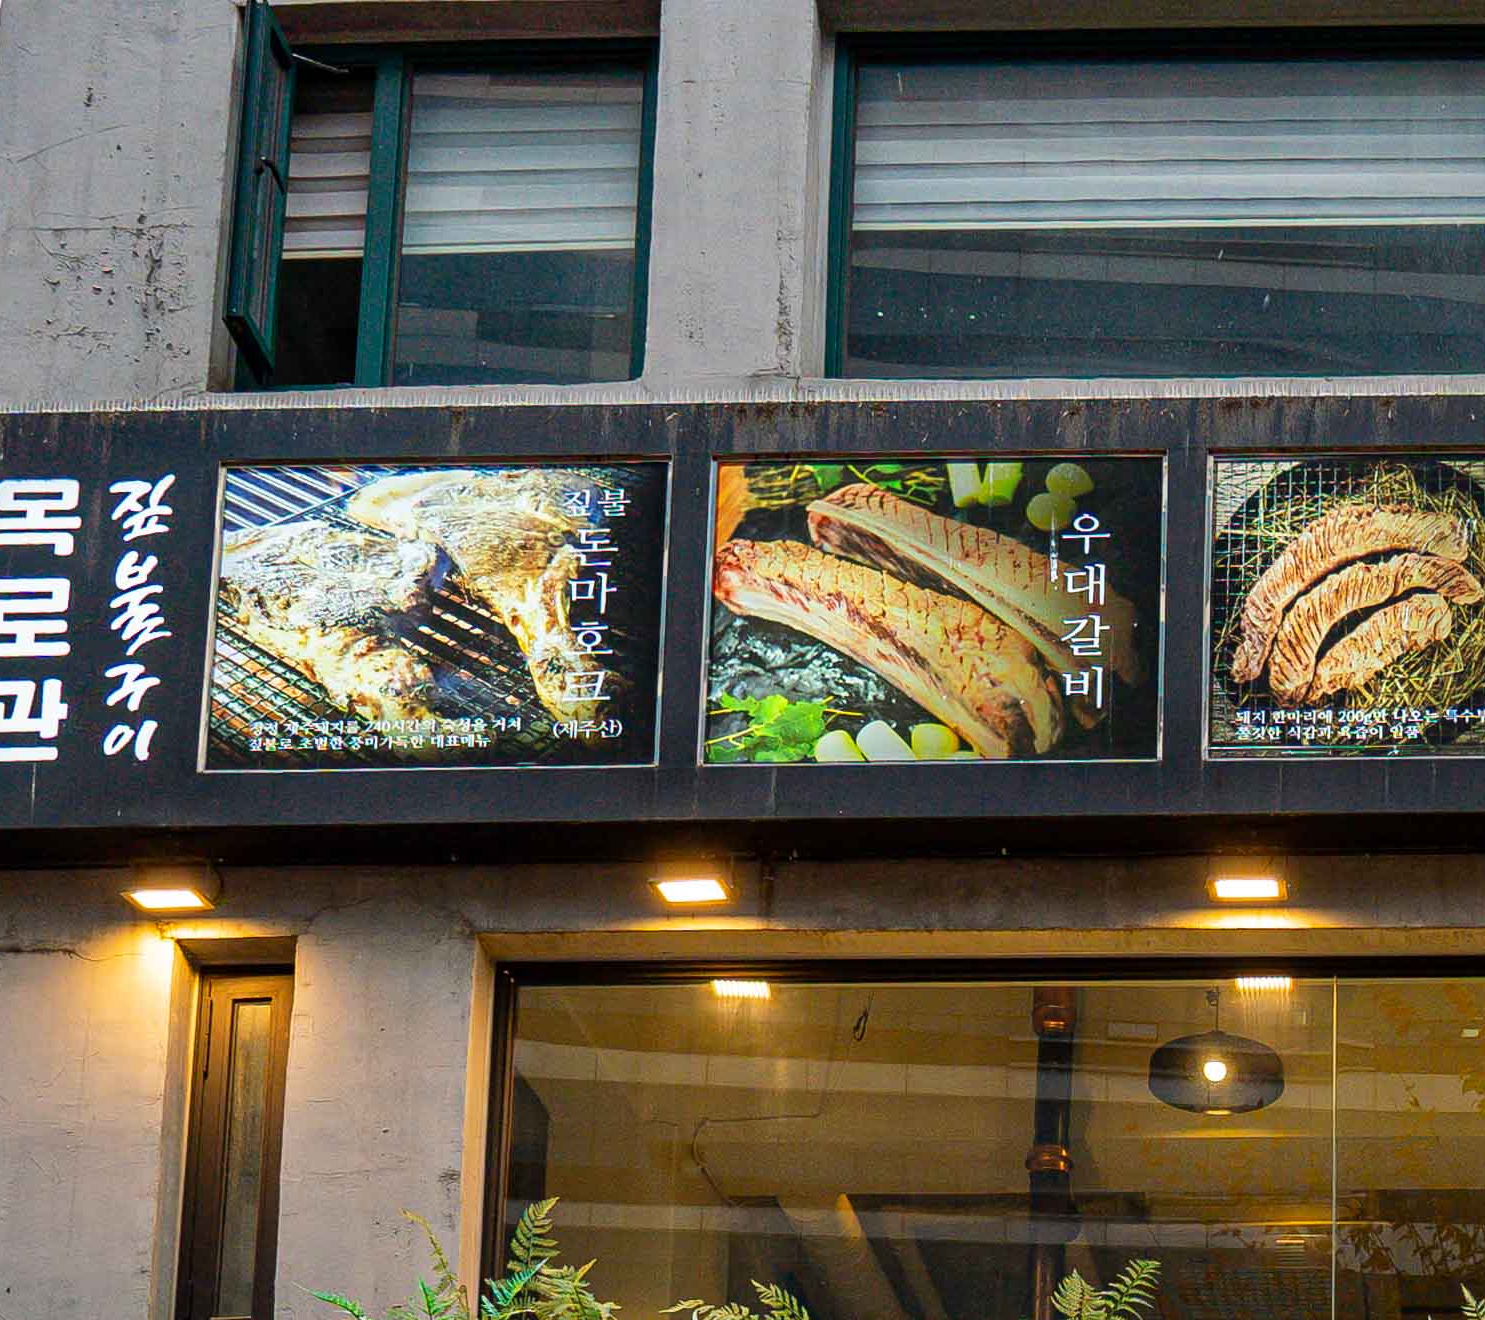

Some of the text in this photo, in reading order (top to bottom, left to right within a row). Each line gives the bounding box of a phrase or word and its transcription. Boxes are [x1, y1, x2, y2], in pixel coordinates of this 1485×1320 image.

[562, 488, 632, 518] 짚불
[103, 472, 176, 763] 짚불구이
[561, 526, 620, 703] 돈마호크
[1058, 511, 1111, 709] 우대갈비
[551, 718, 624, 739] (제주산)
